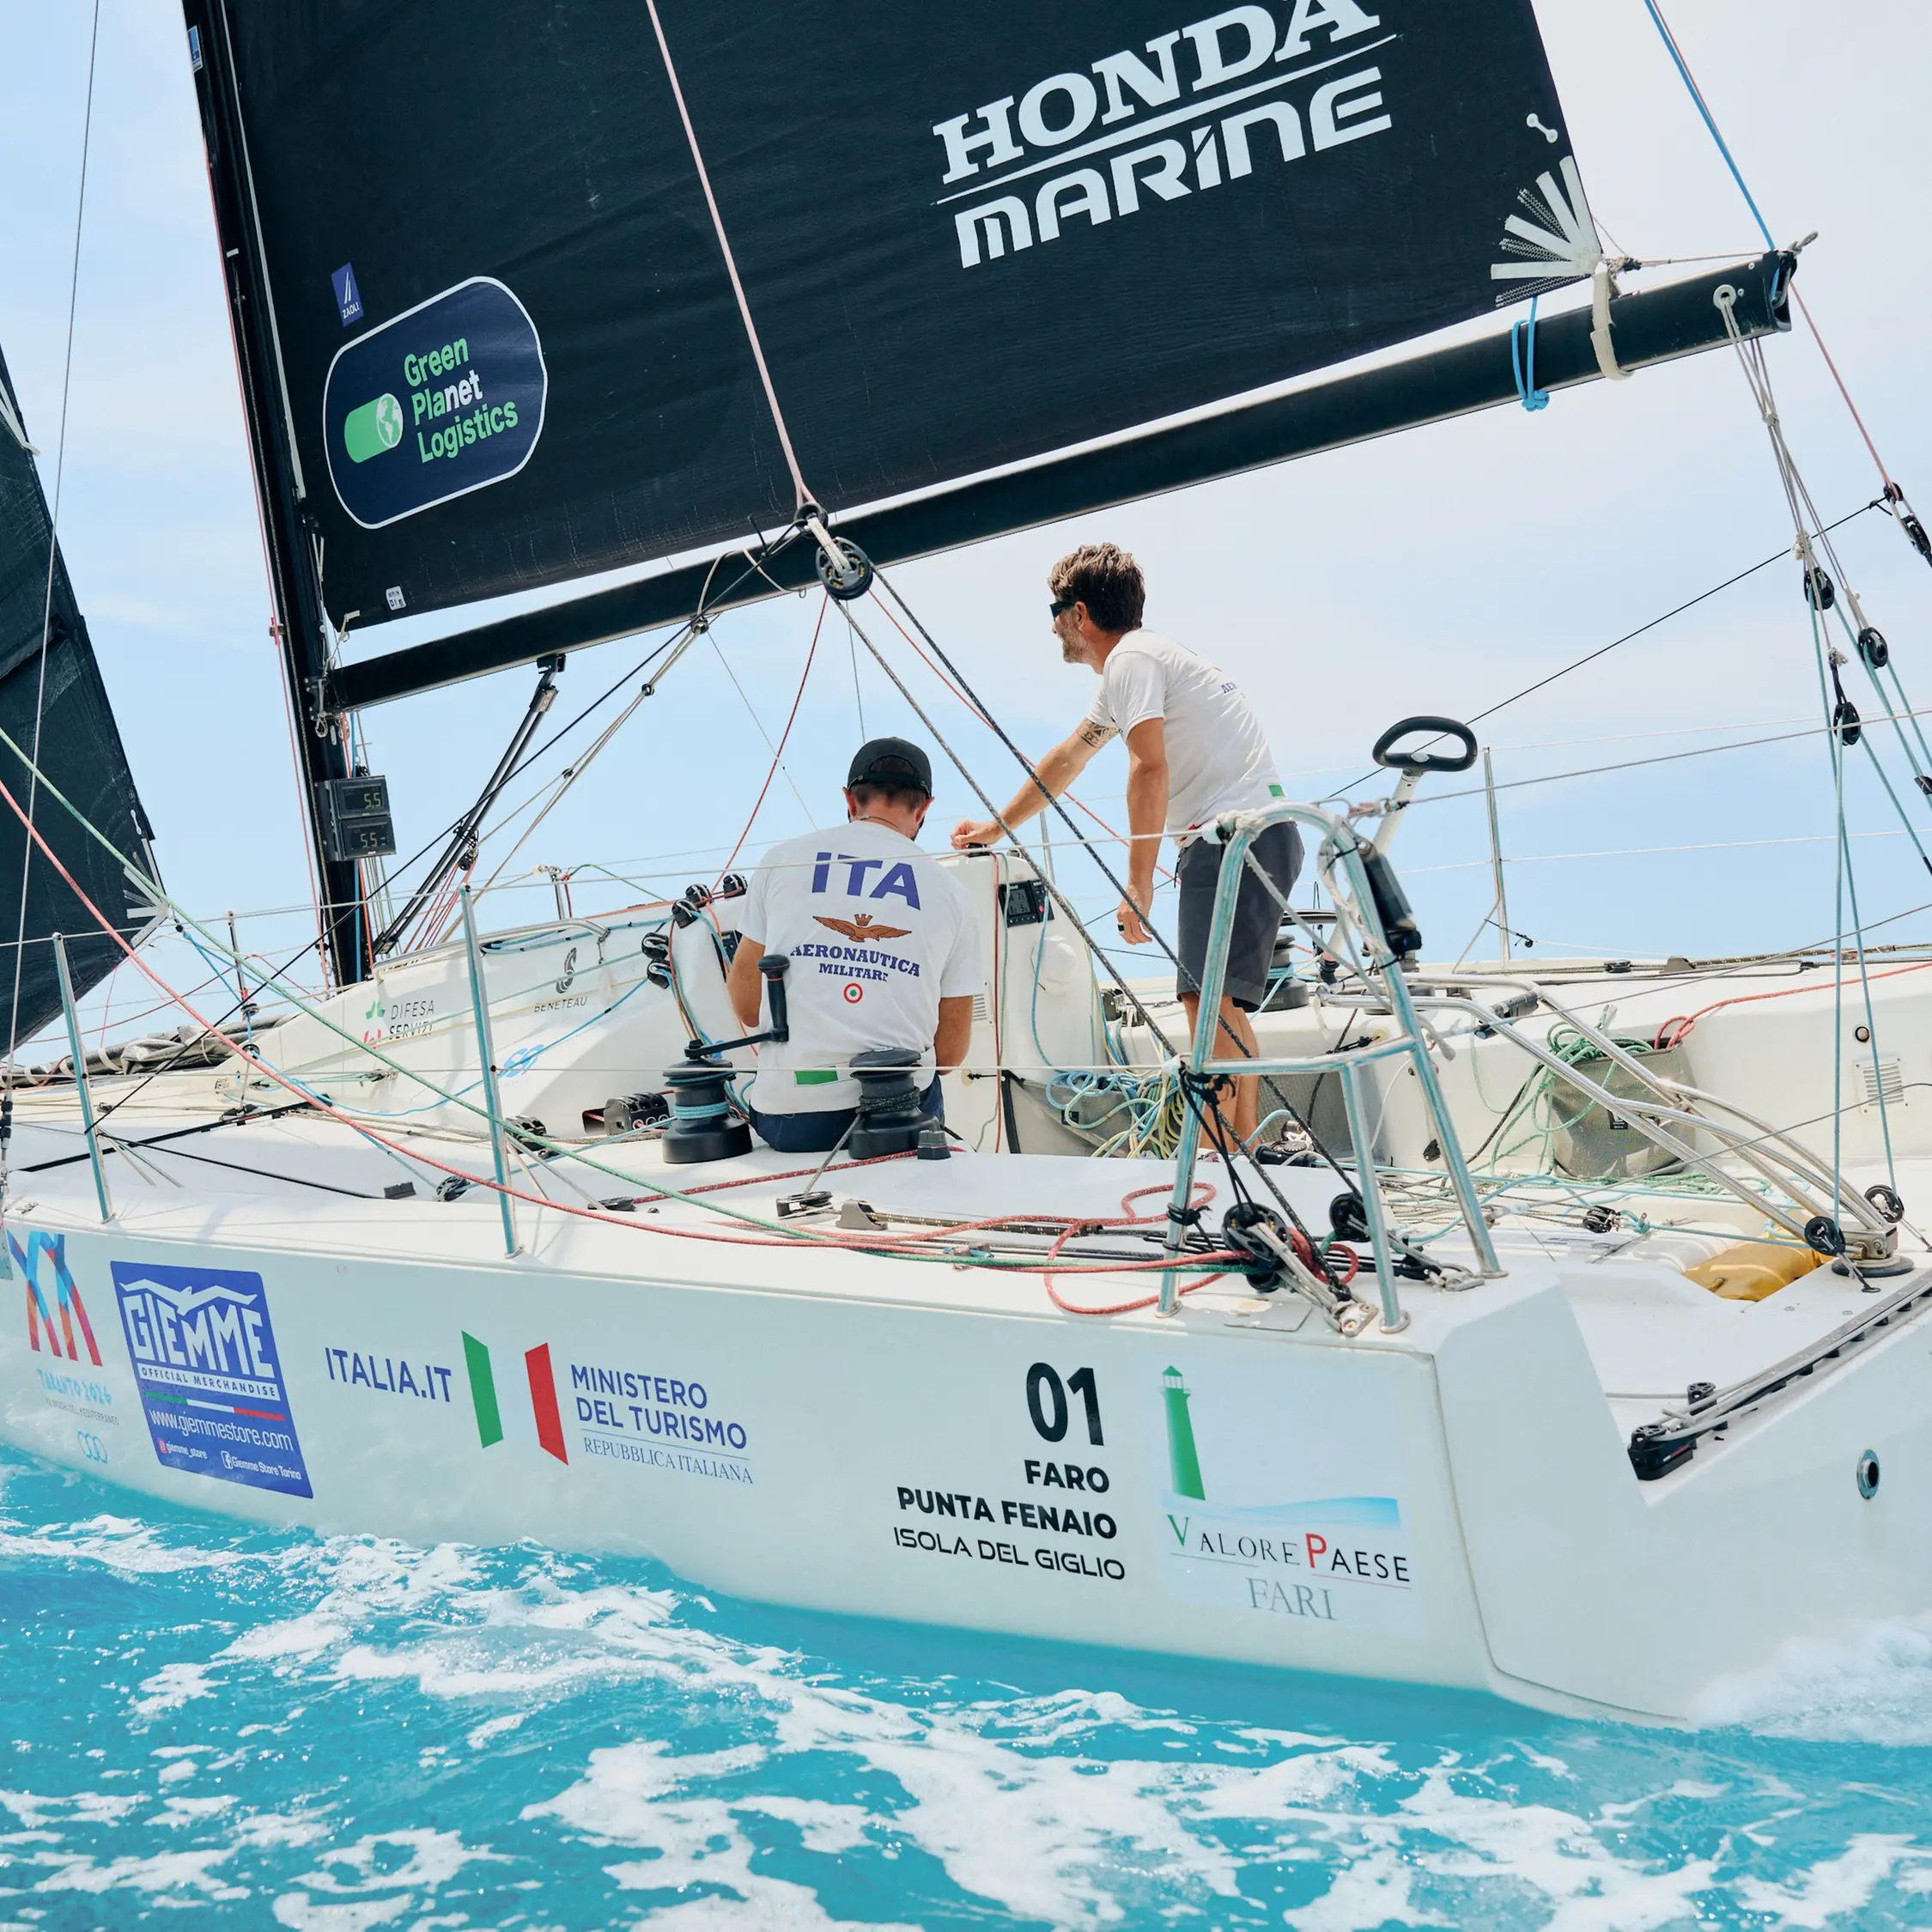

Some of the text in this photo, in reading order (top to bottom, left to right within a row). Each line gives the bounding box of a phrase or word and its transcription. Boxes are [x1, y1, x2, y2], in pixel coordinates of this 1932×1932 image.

[933, 0, 1381, 185] HONDA
[954, 66, 1393, 269] MARINE
[342, 301, 360, 319] ZAOLI
[404, 337, 469, 387] Green
[411, 369, 483, 427] Planet
[417, 401, 519, 464] Logistics
[811, 852, 921, 911] ITA
[790, 944, 920, 978] AERONAUTICA
[819, 963, 889, 982] MILITARE
[391, 999, 434, 1020] DIFESA
[533, 995, 588, 1012] BENETEAU
[123, 1292, 275, 1379] GIEMME
[142, 1367, 276, 1396] OFFICIAL MERCHANDISE
[325, 1346, 453, 1403] ITALIA.IT
[570, 1364, 708, 1409] MINISTERO
[575, 1396, 747, 1449] DEL TURISMO
[1026, 1362, 1104, 1446] 01
[149, 1408, 294, 1451] www.giemmestore.com
[166, 1441, 208, 1459] giemme_store
[231, 1456, 302, 1481] Giemme Store Torino
[583, 1437, 754, 1485] REPUBBLICA ITALIANA
[1024, 1459, 1109, 1493] FARO
[896, 1485, 1117, 1540] PUNTA FENAIO
[894, 1527, 1126, 1580] ISOLA DEL GIGLIO
[1245, 1577, 1338, 1621] FARI
